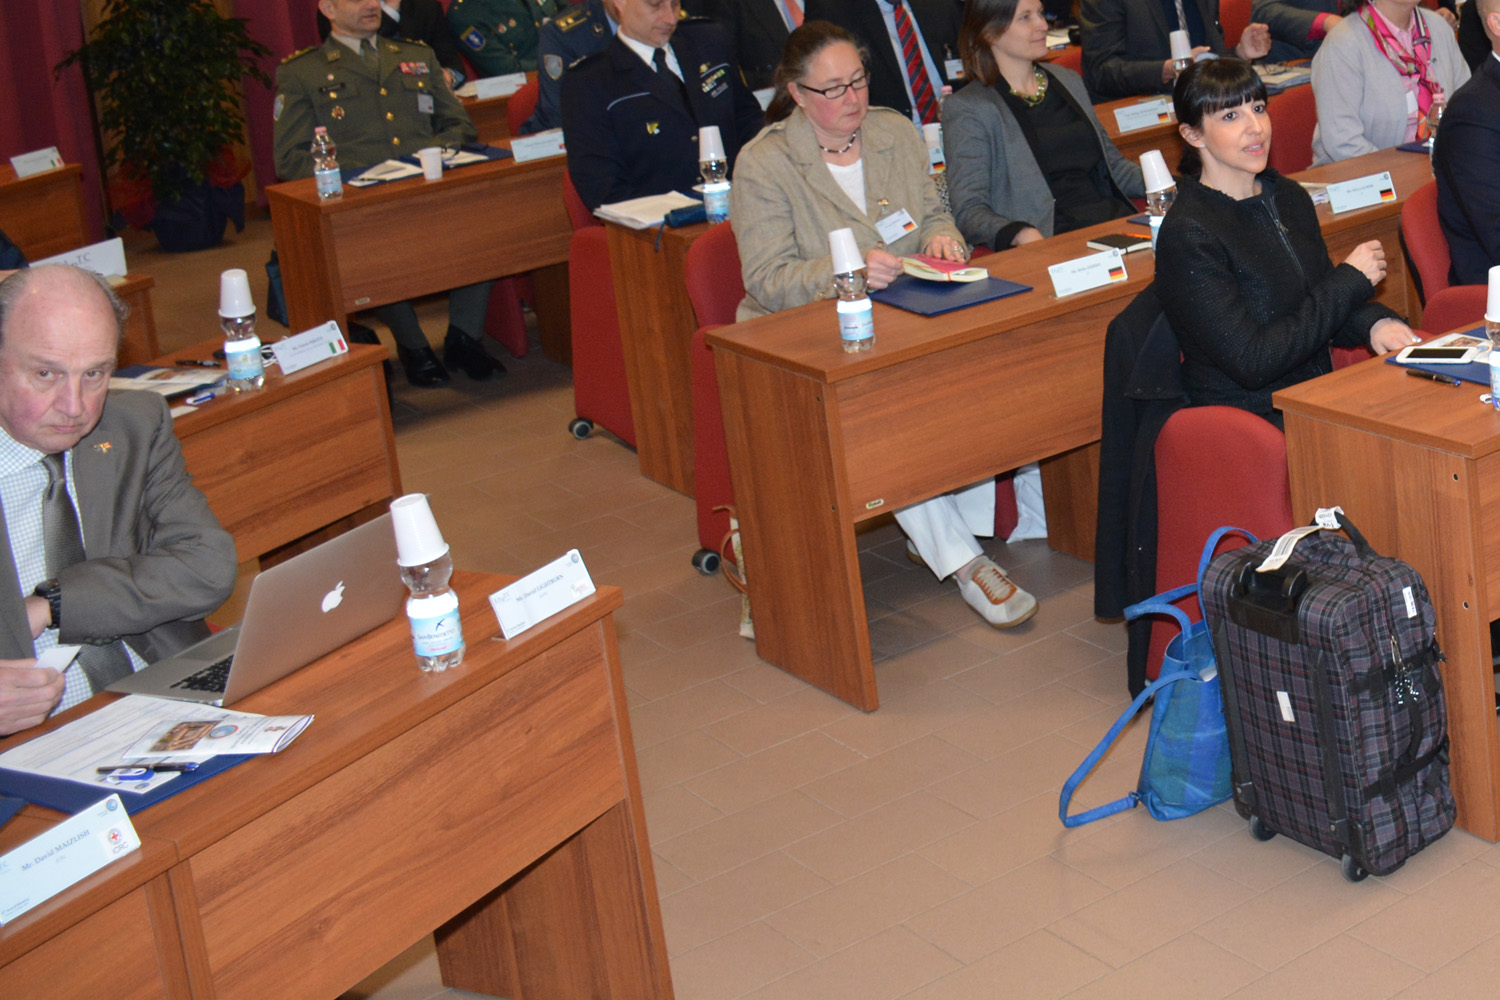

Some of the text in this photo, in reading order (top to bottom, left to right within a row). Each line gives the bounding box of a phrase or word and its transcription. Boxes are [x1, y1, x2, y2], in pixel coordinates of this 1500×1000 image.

[21, 860, 34, 872] Mr.
[34, 849, 55, 865] David
[55, 829, 91, 852] MAIZLISH
[112, 841, 129, 855] ICRC
